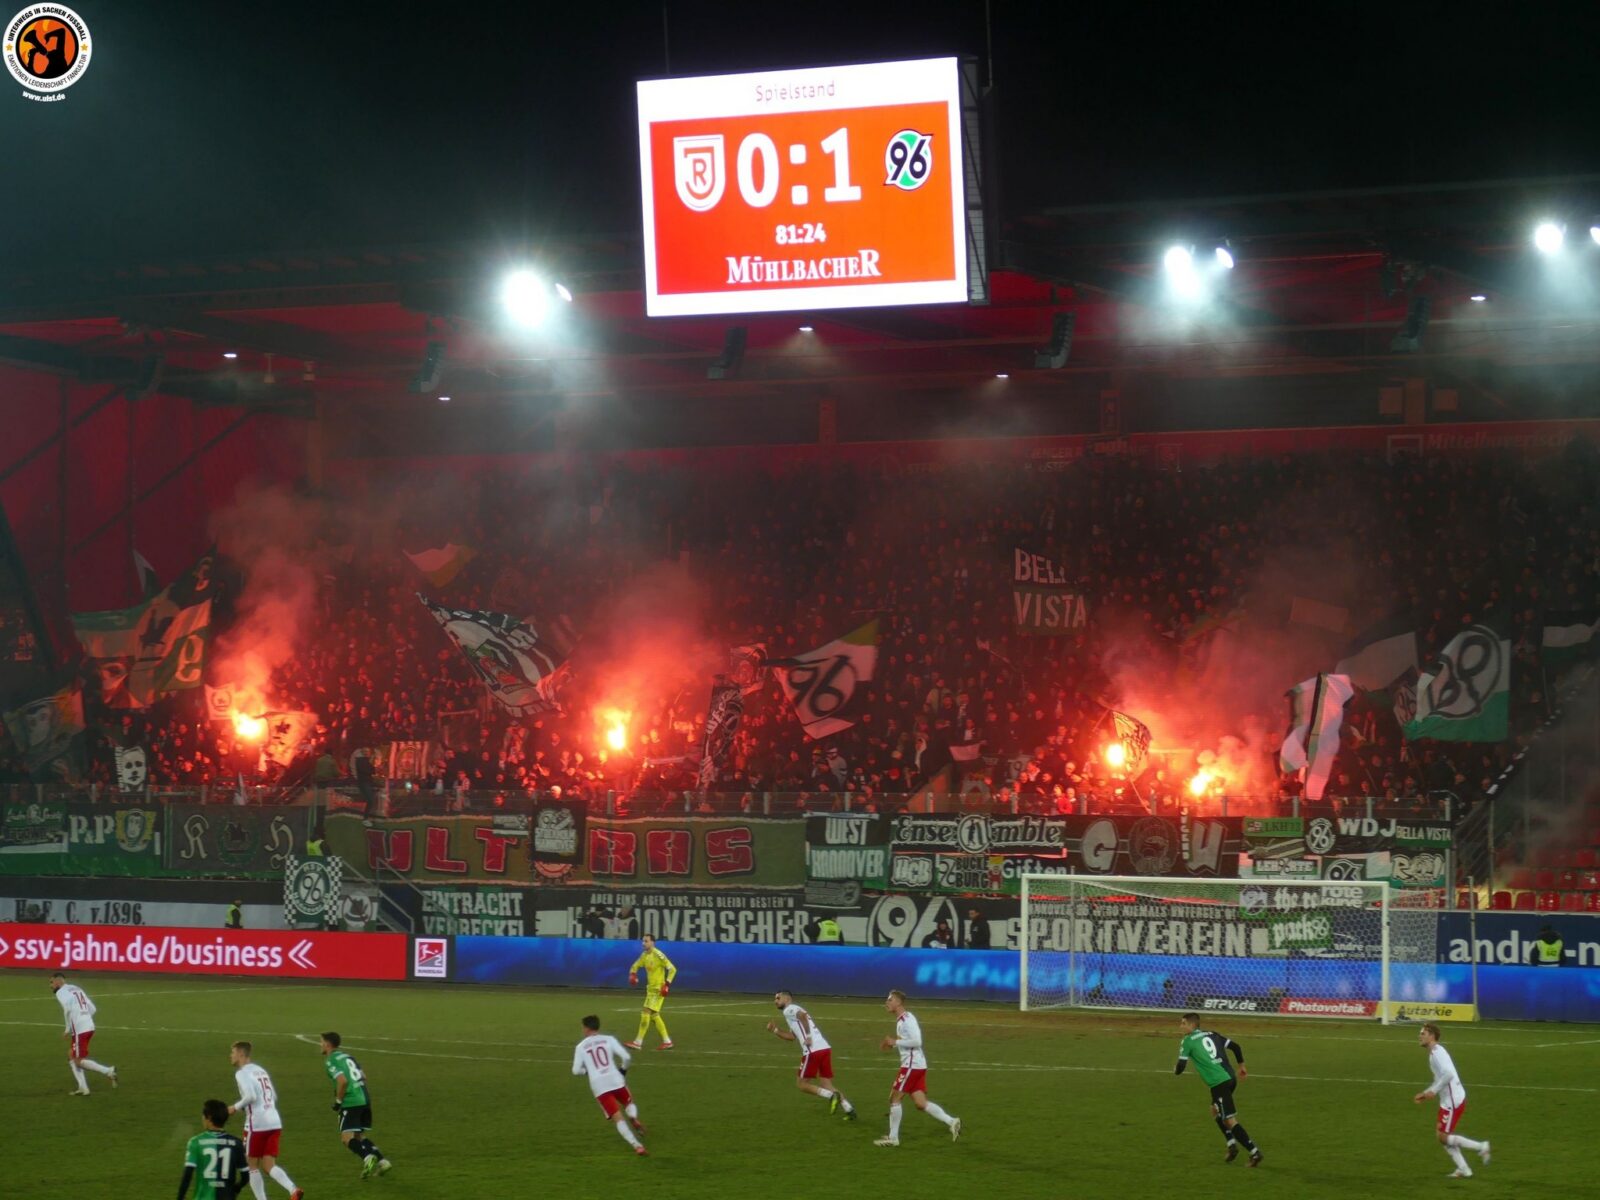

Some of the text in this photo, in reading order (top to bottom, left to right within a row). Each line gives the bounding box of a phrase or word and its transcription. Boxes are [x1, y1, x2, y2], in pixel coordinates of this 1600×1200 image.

[755, 81, 835, 104] Spielstand
[890, 139, 928, 182] 96
[775, 222, 827, 245] 81:24
[1013, 591, 1087, 628] VISTA
[825, 817, 871, 845] WEST
[1396, 825, 1452, 841] BELLA VISTA
[422, 890, 523, 916] EINTRACHT
[590, 893, 613, 905] ABER
[642, 895, 666, 907] ABER
[695, 895, 714, 908] DAS
[716, 896, 747, 908] BLEIBT
[1007, 917, 1246, 957] SPORTVEREIN
[14, 933, 283, 968] ssv-jahn.de/business
[73, 991, 87, 1010] 14
[1288, 1000, 1366, 1015] Photovoltaik
[586, 1046, 609, 1069] 10
[1202, 1036, 1218, 1059] 9
[345, 1058, 362, 1082] 8
[257, 1077, 273, 1103] 15
[202, 1147, 232, 1179] 21
